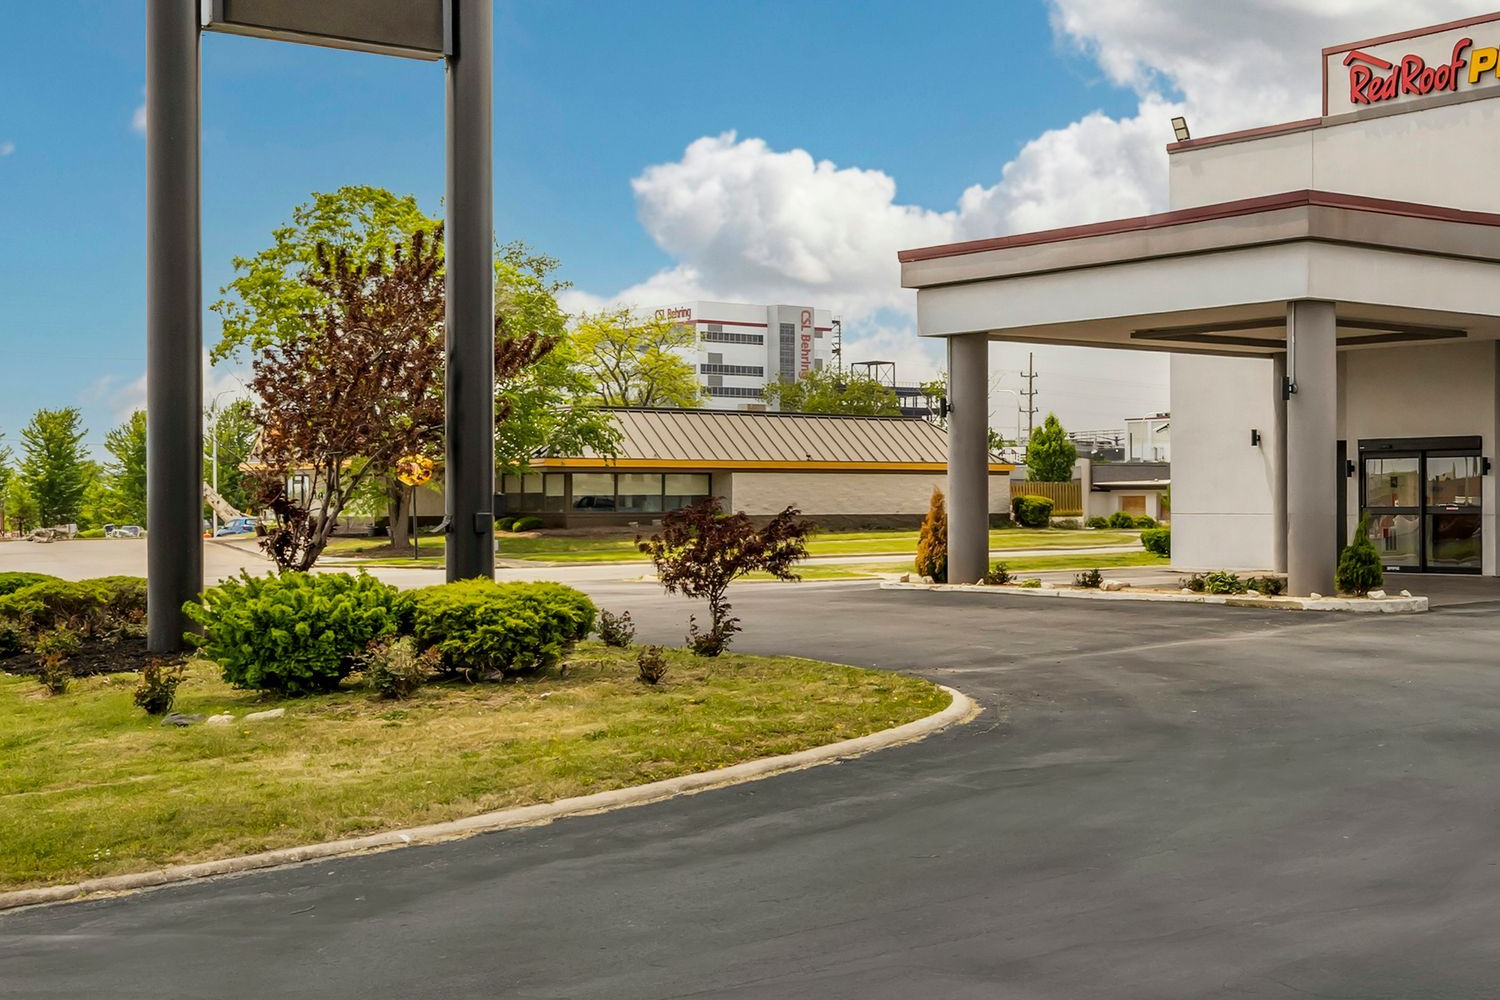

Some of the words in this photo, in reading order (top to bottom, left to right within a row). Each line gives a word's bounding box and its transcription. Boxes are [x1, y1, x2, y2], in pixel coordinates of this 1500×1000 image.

[1350, 63, 1399, 105] Red
[1401, 37, 1472, 95] Roof
[667, 306, 691, 321] Behring
[800, 310, 811, 331] CSL
